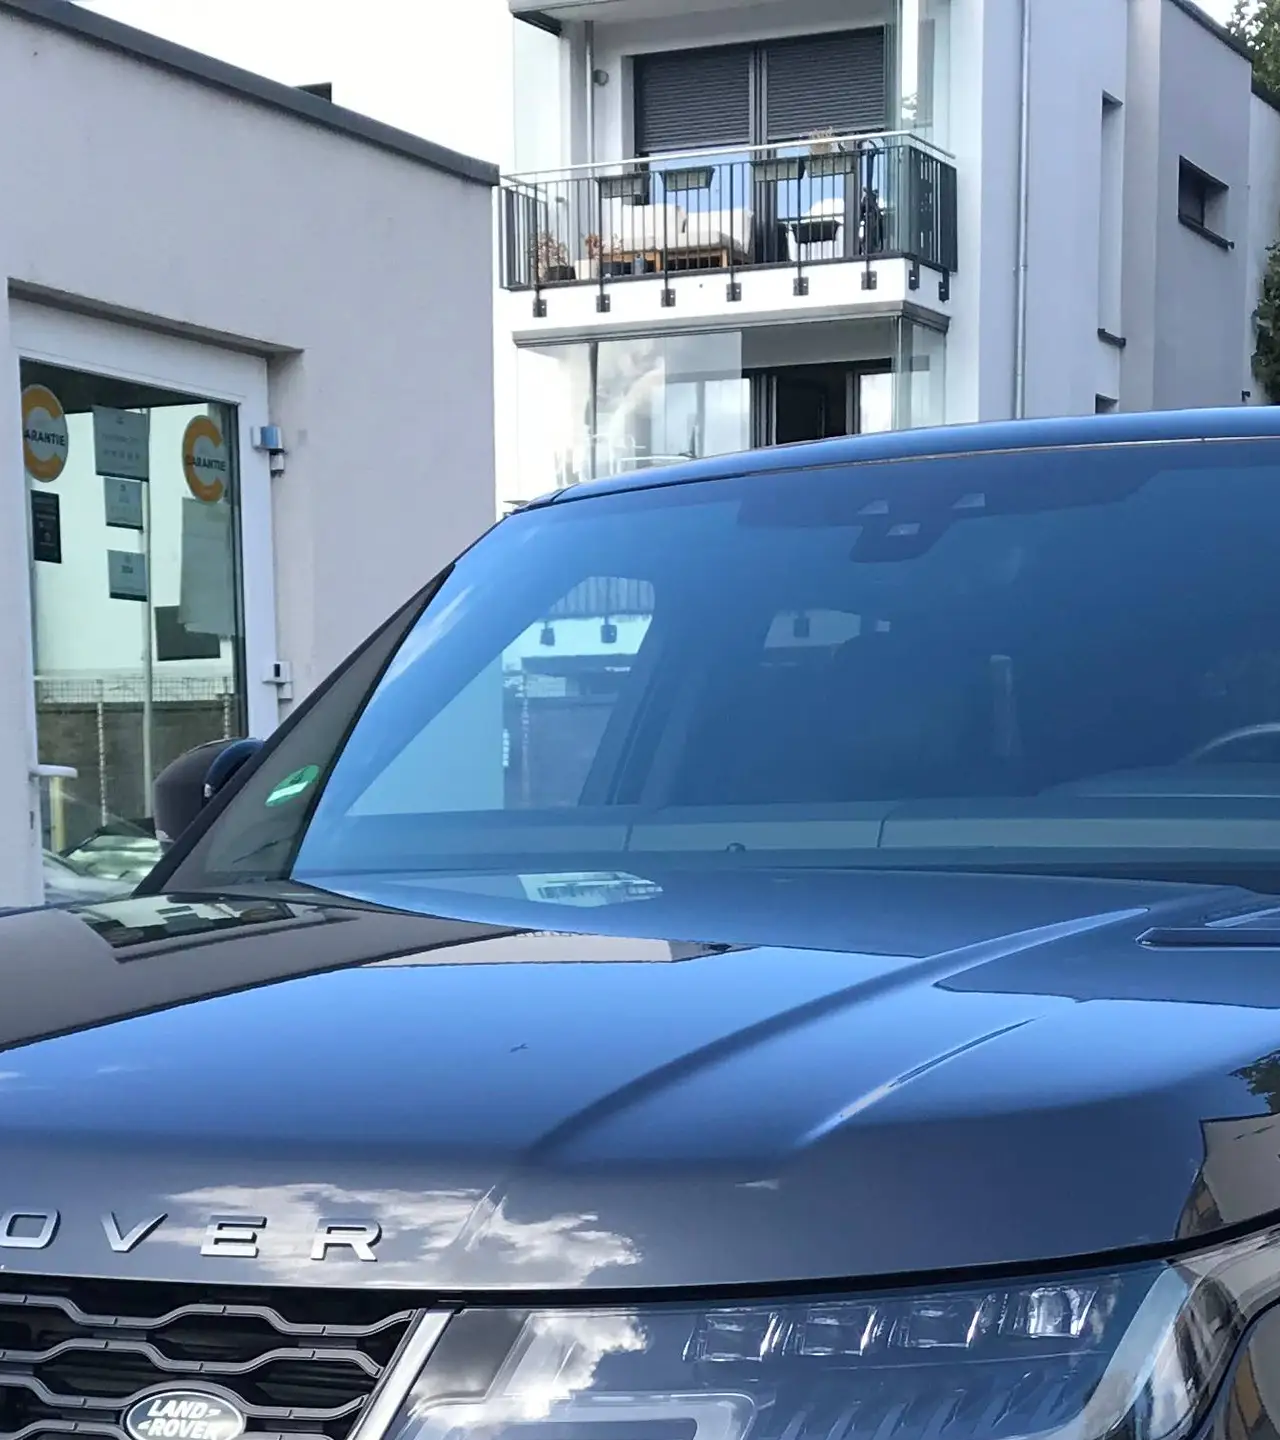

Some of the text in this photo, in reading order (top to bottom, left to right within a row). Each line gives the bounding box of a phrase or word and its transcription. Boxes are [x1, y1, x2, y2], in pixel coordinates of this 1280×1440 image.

[23, 429, 66, 446] ARANTIE
[147, 1399, 209, 1418] LAND
[147, 1417, 222, 1440] ROVER
